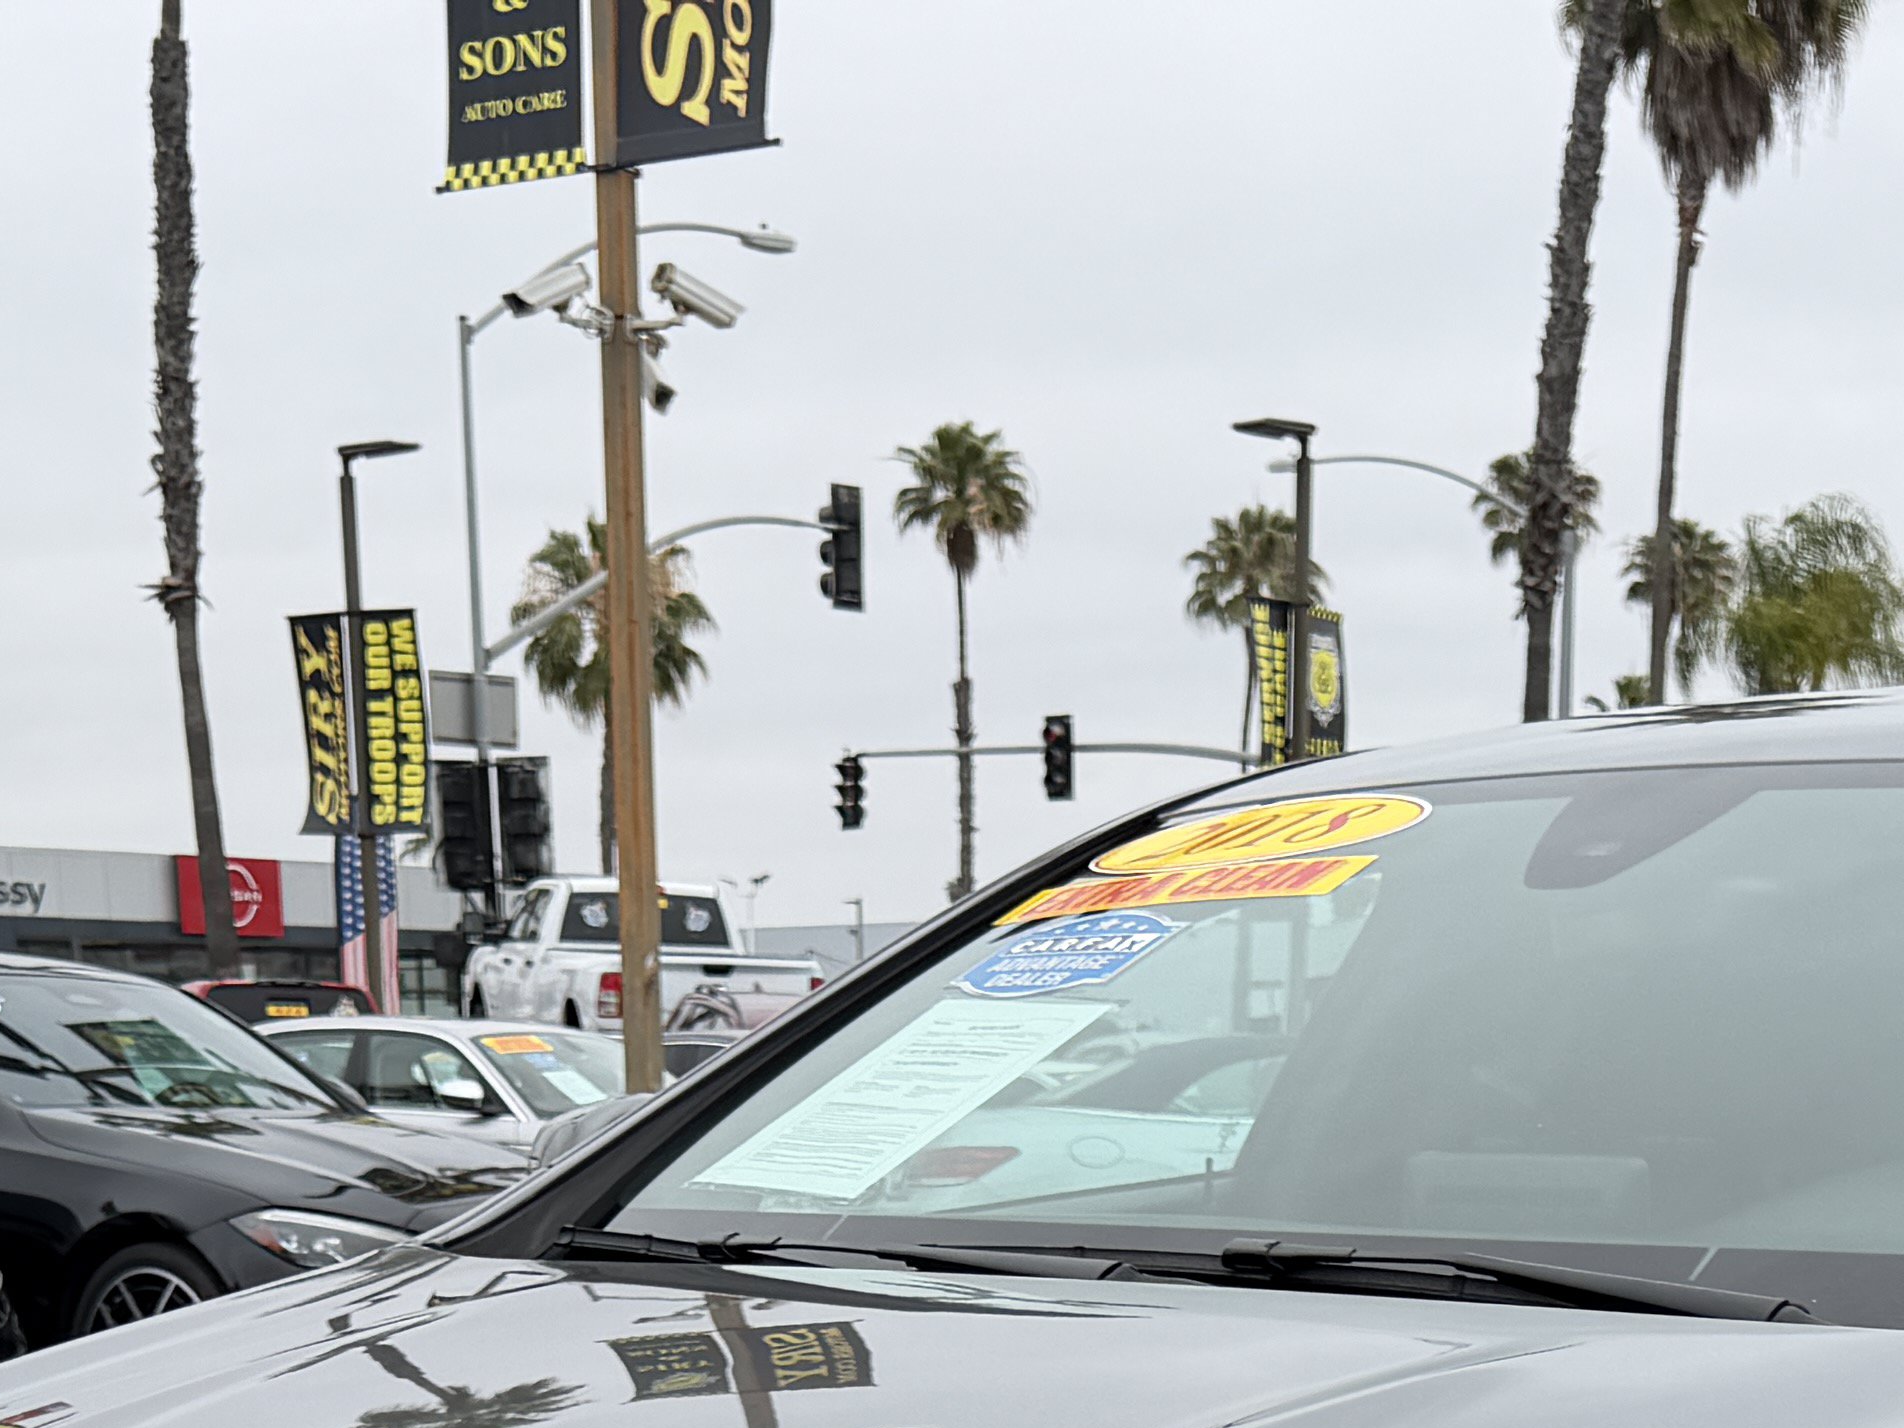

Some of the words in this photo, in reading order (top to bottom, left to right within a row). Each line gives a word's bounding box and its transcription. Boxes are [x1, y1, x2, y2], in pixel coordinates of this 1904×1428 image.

[458, 26, 567, 81] SONS
[640, 0, 716, 127] S
[719, 0, 752, 118] MO
[461, 96, 513, 123] AUTO
[514, 89, 567, 117] CARE
[362, 620, 392, 690] OUR
[389, 617, 418, 671] WE
[295, 623, 339, 826] SIRY
[395, 677, 426, 826] SUPPORT
[365, 696, 397, 826] TROOPS
[1129, 802, 1388, 865] 2018
[1020, 872, 1186, 918] EXTRA
[1167, 860, 1350, 898] CLEAN
[986, 955, 1111, 973] ADVANTAGE
[1009, 932, 1160, 954] CARFAX
[983, 972, 1072, 988] DEALER
